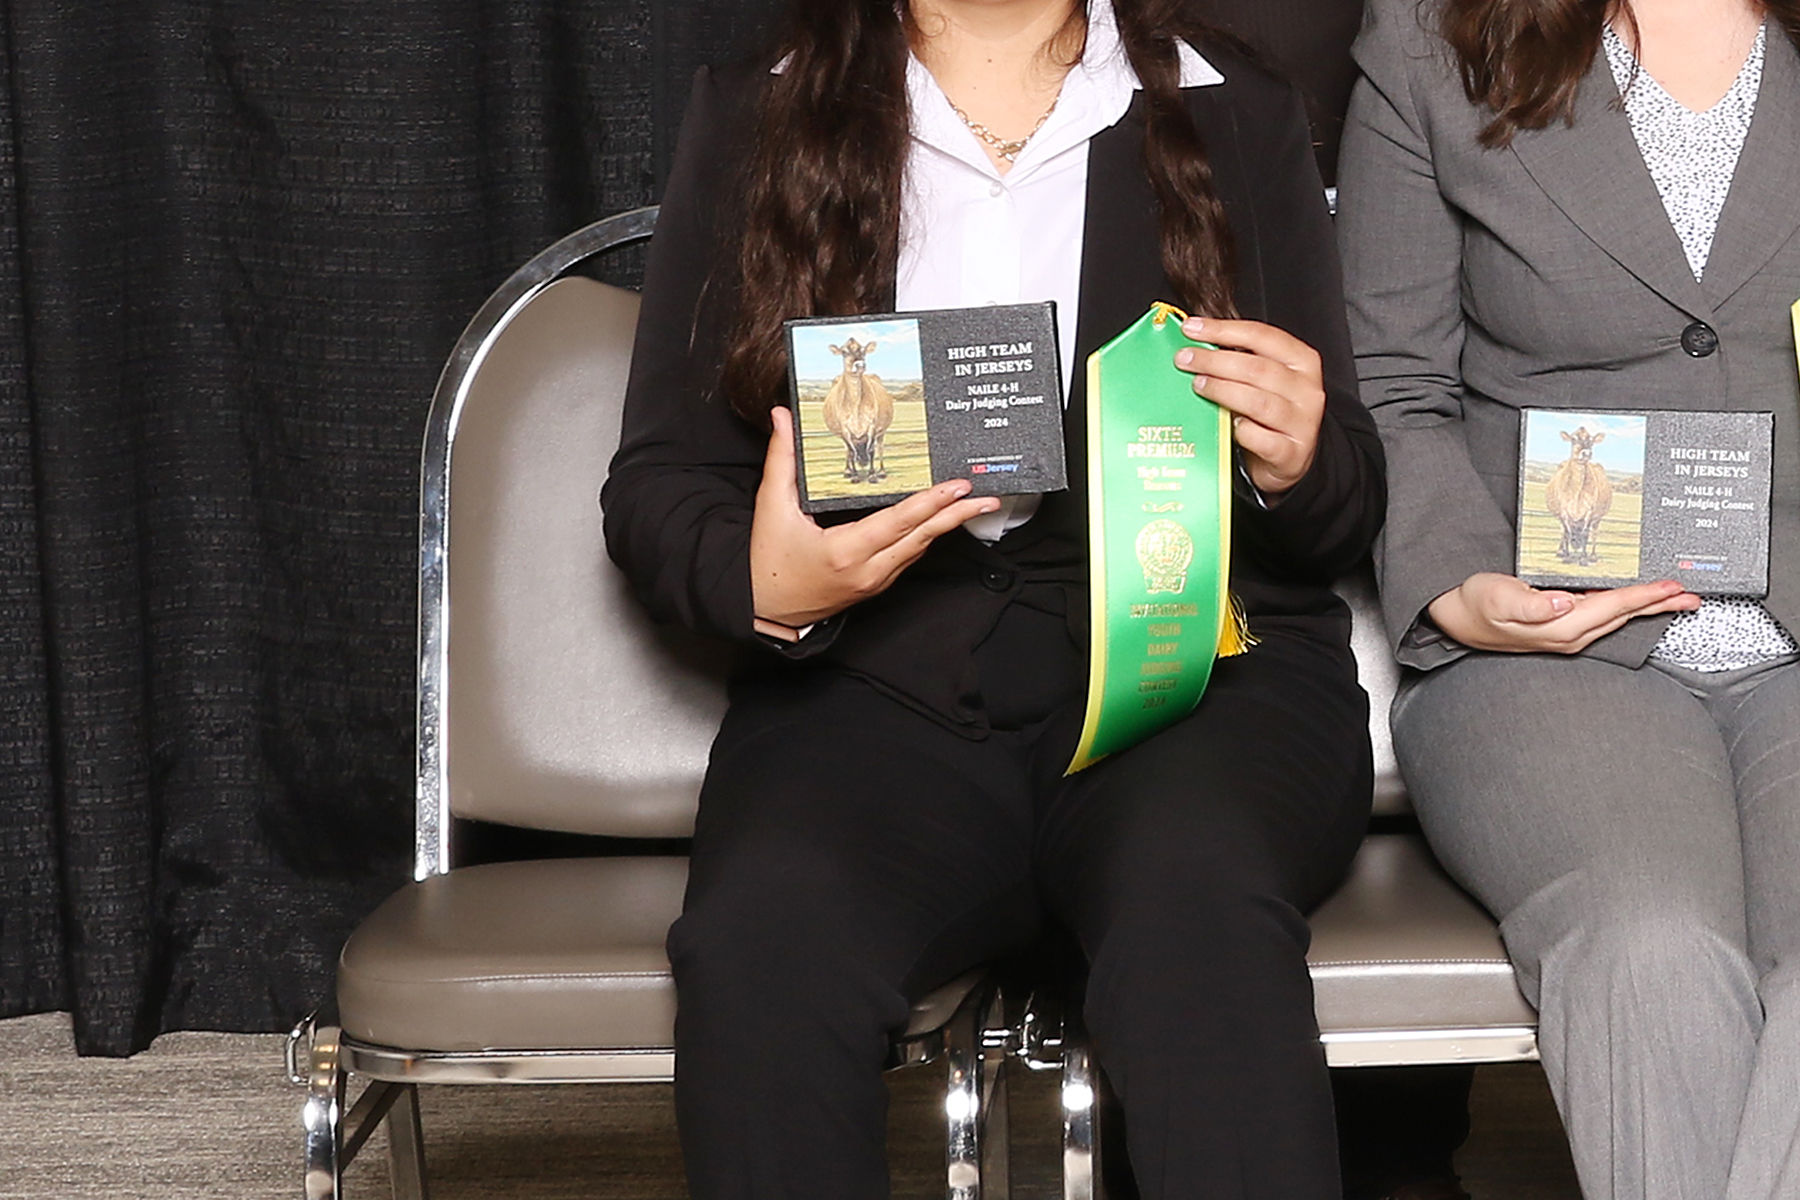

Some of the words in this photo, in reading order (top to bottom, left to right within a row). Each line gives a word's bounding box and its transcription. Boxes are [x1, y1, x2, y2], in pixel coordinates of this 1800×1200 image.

[947, 346, 987, 360] HIGH
[989, 342, 1033, 357] TEAM
[955, 364, 972, 376] IN
[974, 359, 1033, 377] JERSEYS
[967, 384, 1000, 396] NAILE
[1000, 382, 1019, 394] 4-H
[945, 400, 971, 412] Dairy
[972, 397, 1009, 410] Judging
[1008, 395, 1044, 406] Contest
[983, 417, 1009, 429] 2024
[1138, 426, 1183, 442] SIXTH
[1127, 443, 1196, 458] PREMIUM
[1670, 448, 1707, 460] HIGH
[1709, 449, 1750, 462] TEAM
[971, 464, 1019, 474] USJersey
[1674, 464, 1691, 475] IN
[1693, 465, 1749, 478] JERSEYS
[1684, 485, 1714, 496] NAILE
[1714, 487, 1733, 497] 4-H
[1661, 497, 1686, 509] Dairy
[1686, 497, 1720, 511] Judging
[1721, 499, 1755, 510] Contest
[1695, 518, 1718, 528] 2024
[1148, 623, 1181, 637] YOUTH
[1147, 643, 1178, 656] DAIRY
